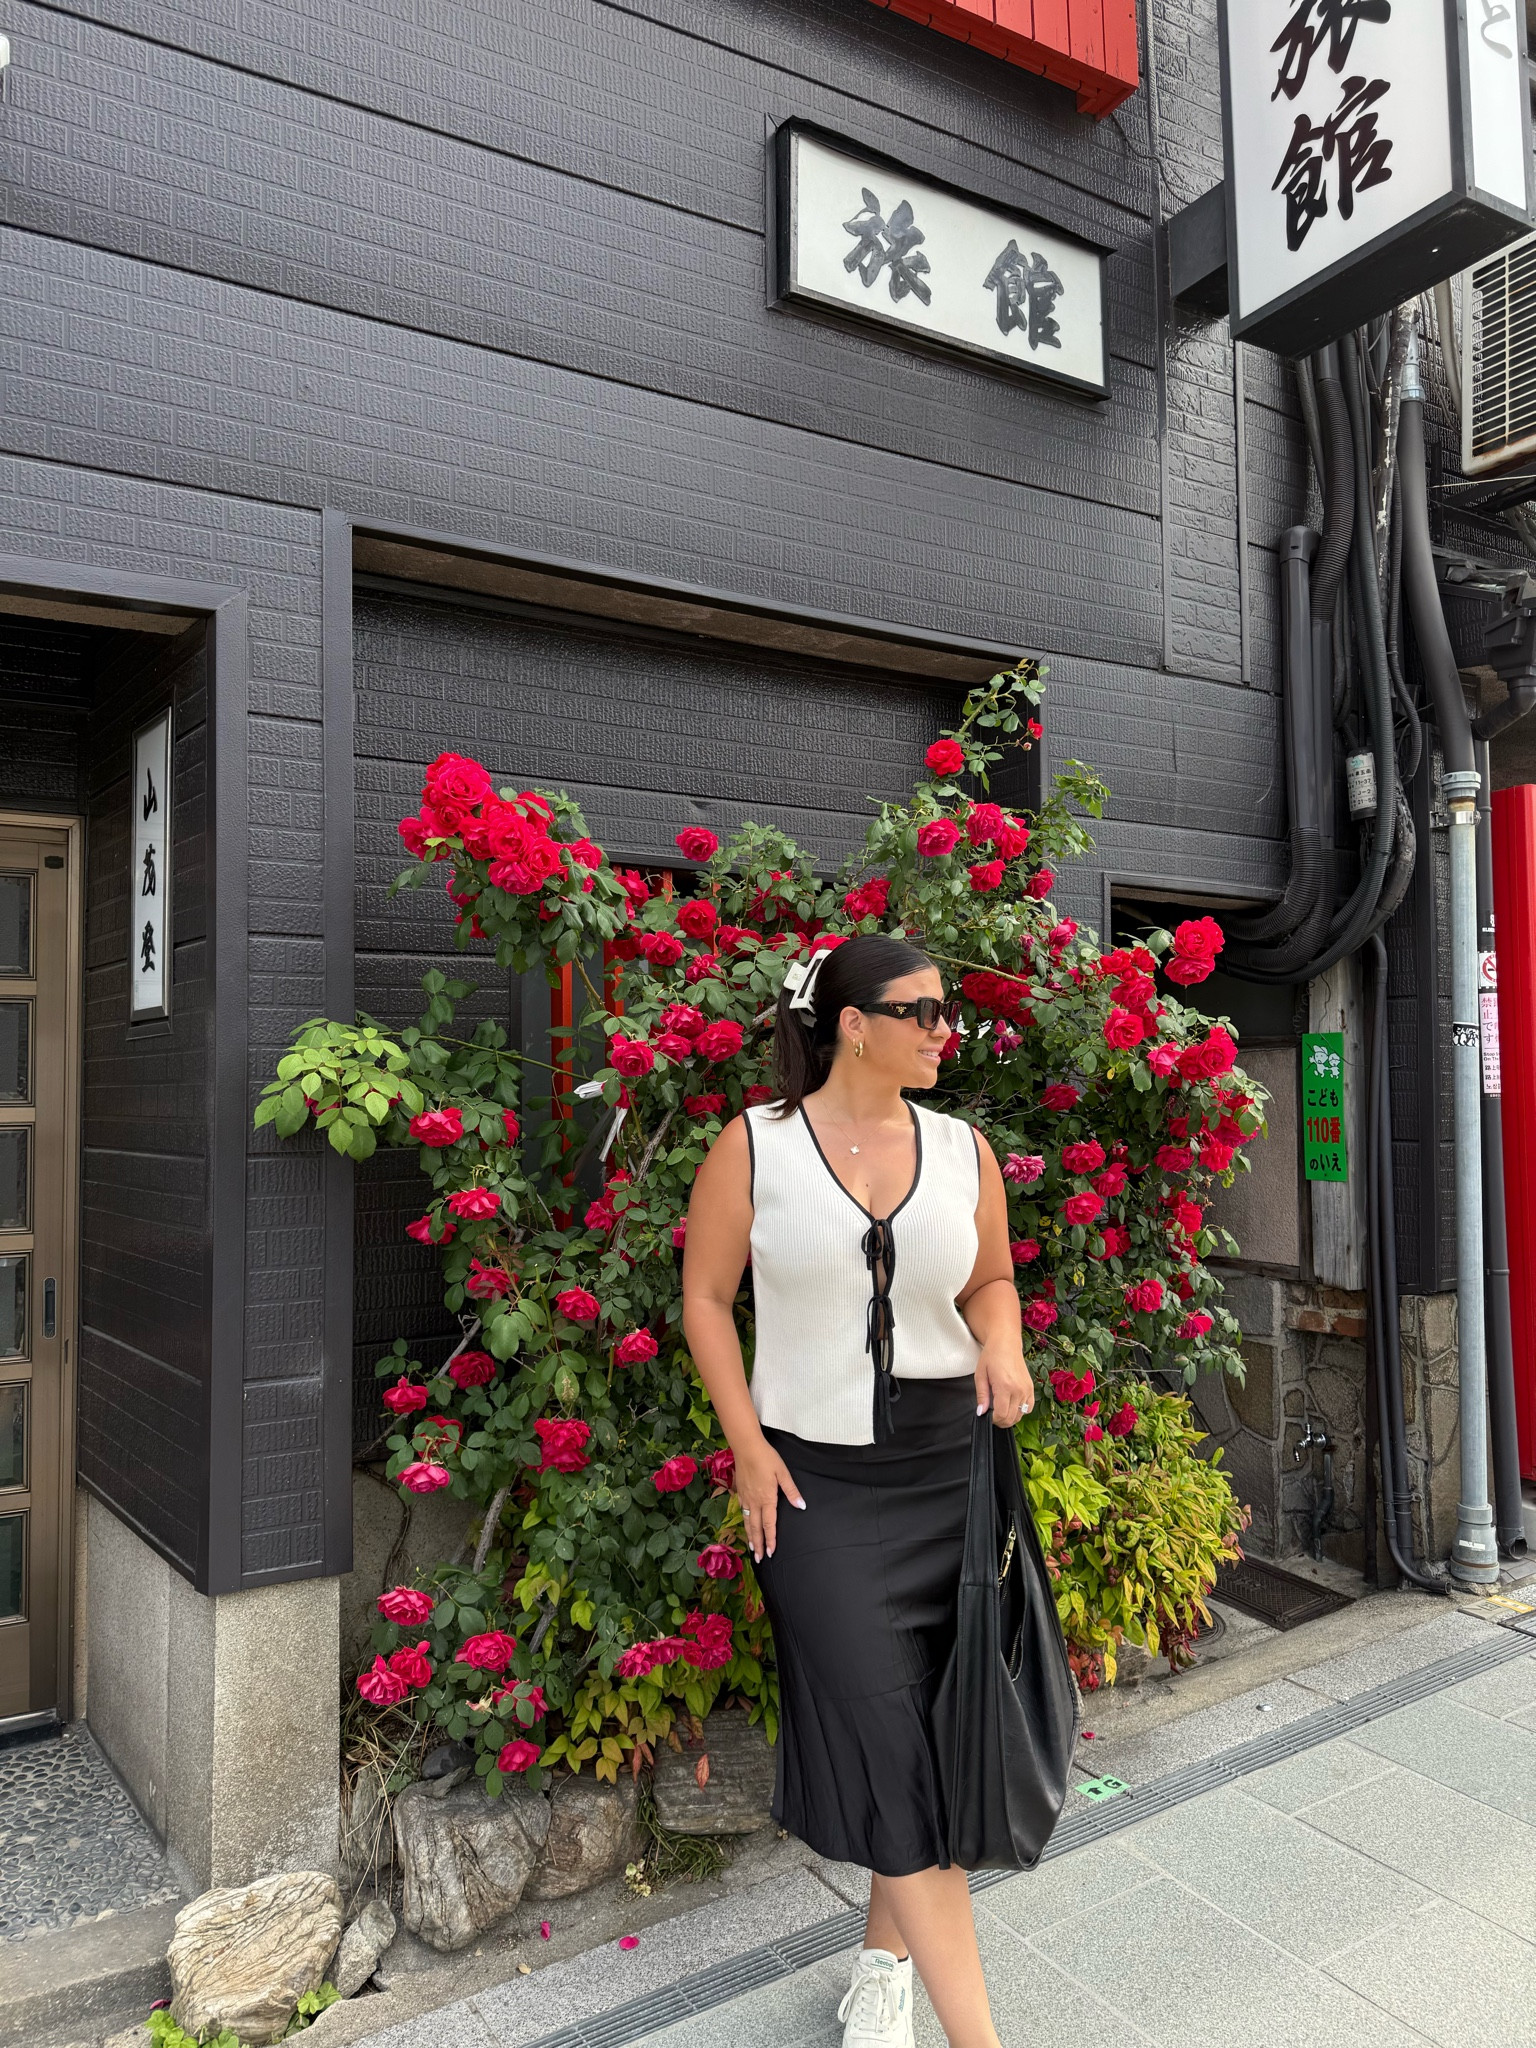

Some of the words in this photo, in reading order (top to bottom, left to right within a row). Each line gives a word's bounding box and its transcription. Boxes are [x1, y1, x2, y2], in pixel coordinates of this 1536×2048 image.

[842, 187, 1064, 351] 旅館
[1307, 1088, 1339, 1107] こども
[1306, 1116, 1342, 1144] 110番
[1309, 1152, 1342, 1172] のいえ
[1103, 1779, 1122, 1789] G
